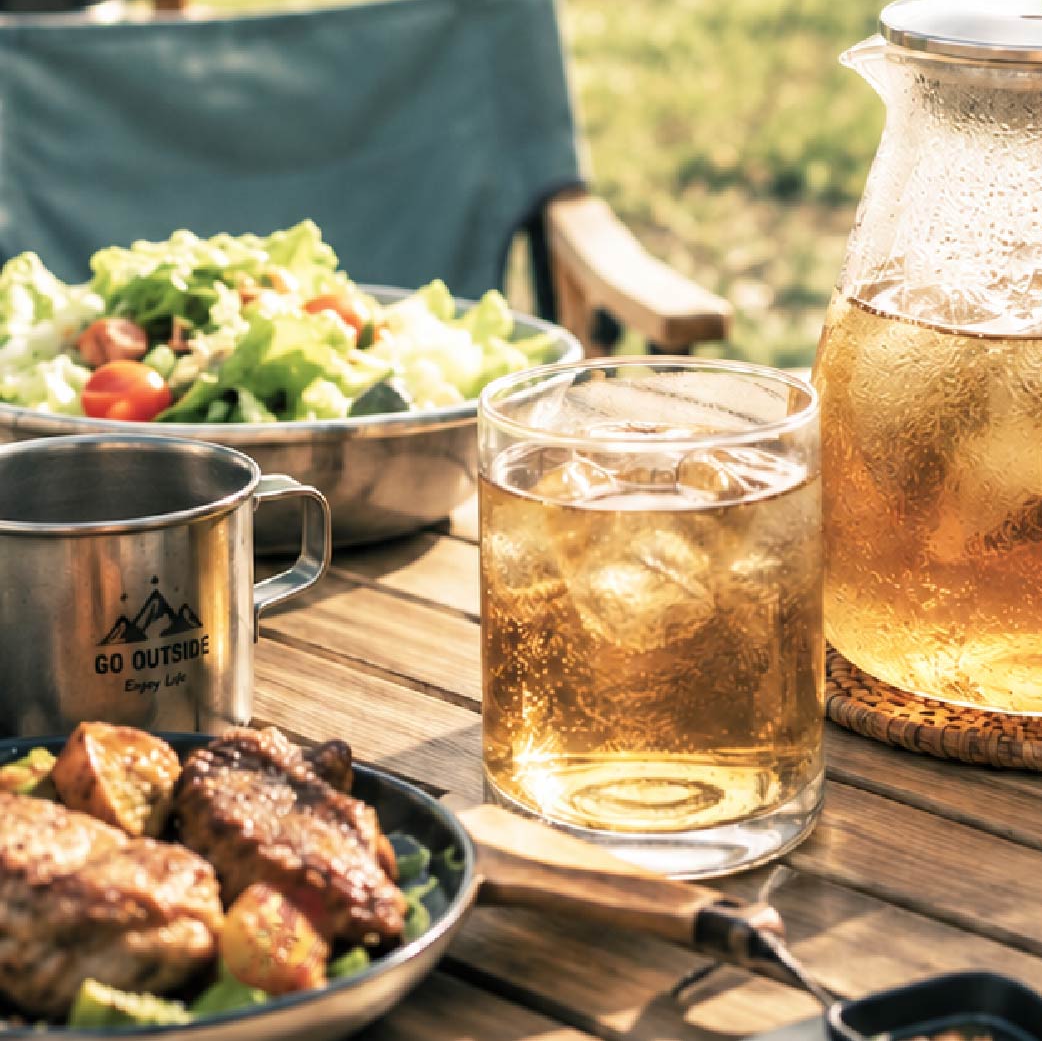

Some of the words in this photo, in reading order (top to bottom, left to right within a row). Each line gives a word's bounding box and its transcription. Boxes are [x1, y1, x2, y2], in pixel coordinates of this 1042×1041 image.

[95, 653, 123, 674] GO
[132, 634, 209, 670] OUTSIDE
[124, 678, 160, 694] Enjoy
[166, 672, 186, 687] Life
